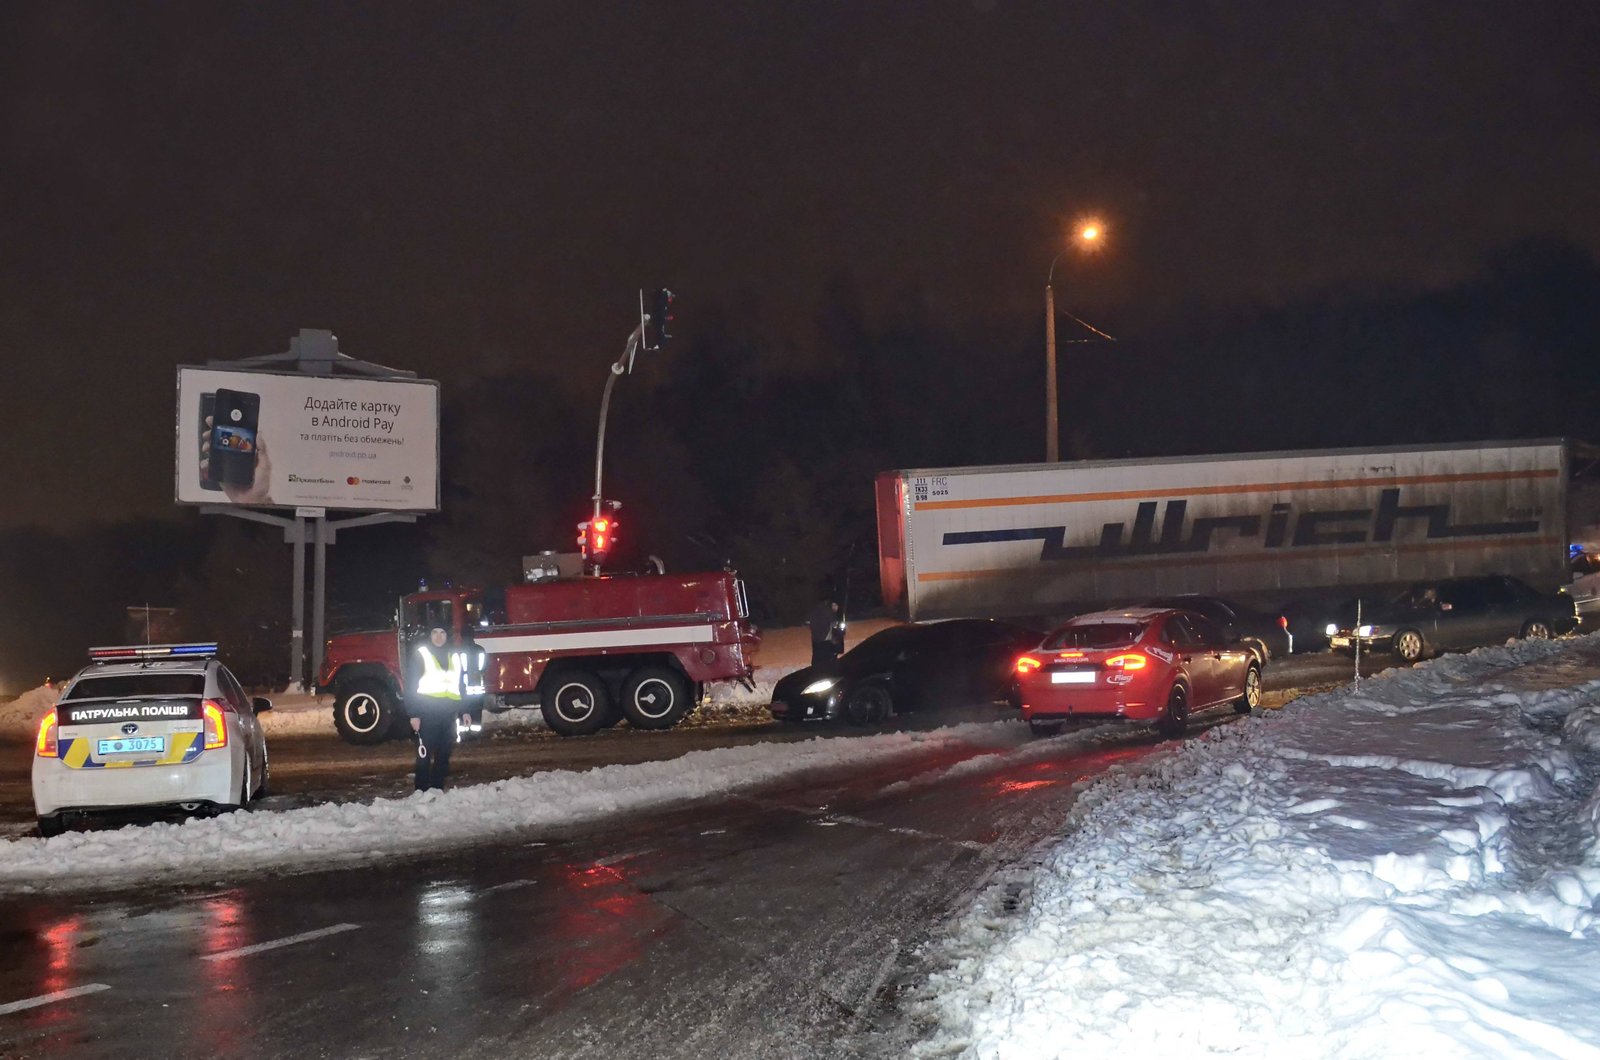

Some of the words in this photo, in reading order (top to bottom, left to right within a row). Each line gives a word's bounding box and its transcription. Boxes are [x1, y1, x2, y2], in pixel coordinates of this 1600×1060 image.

[304, 396, 357, 412] Додайте
[361, 401, 401, 417] картку
[311, 417, 319, 426] в
[322, 415, 370, 429] Android
[373, 417, 394, 433] Pay
[311, 433, 342, 443] платіть
[344, 433, 358, 443] без
[71, 709, 139, 721] ПАТРУЛЬНА
[141, 706, 188, 717] ПОЛІЦІЯ
[129, 739, 157, 750] 3075
